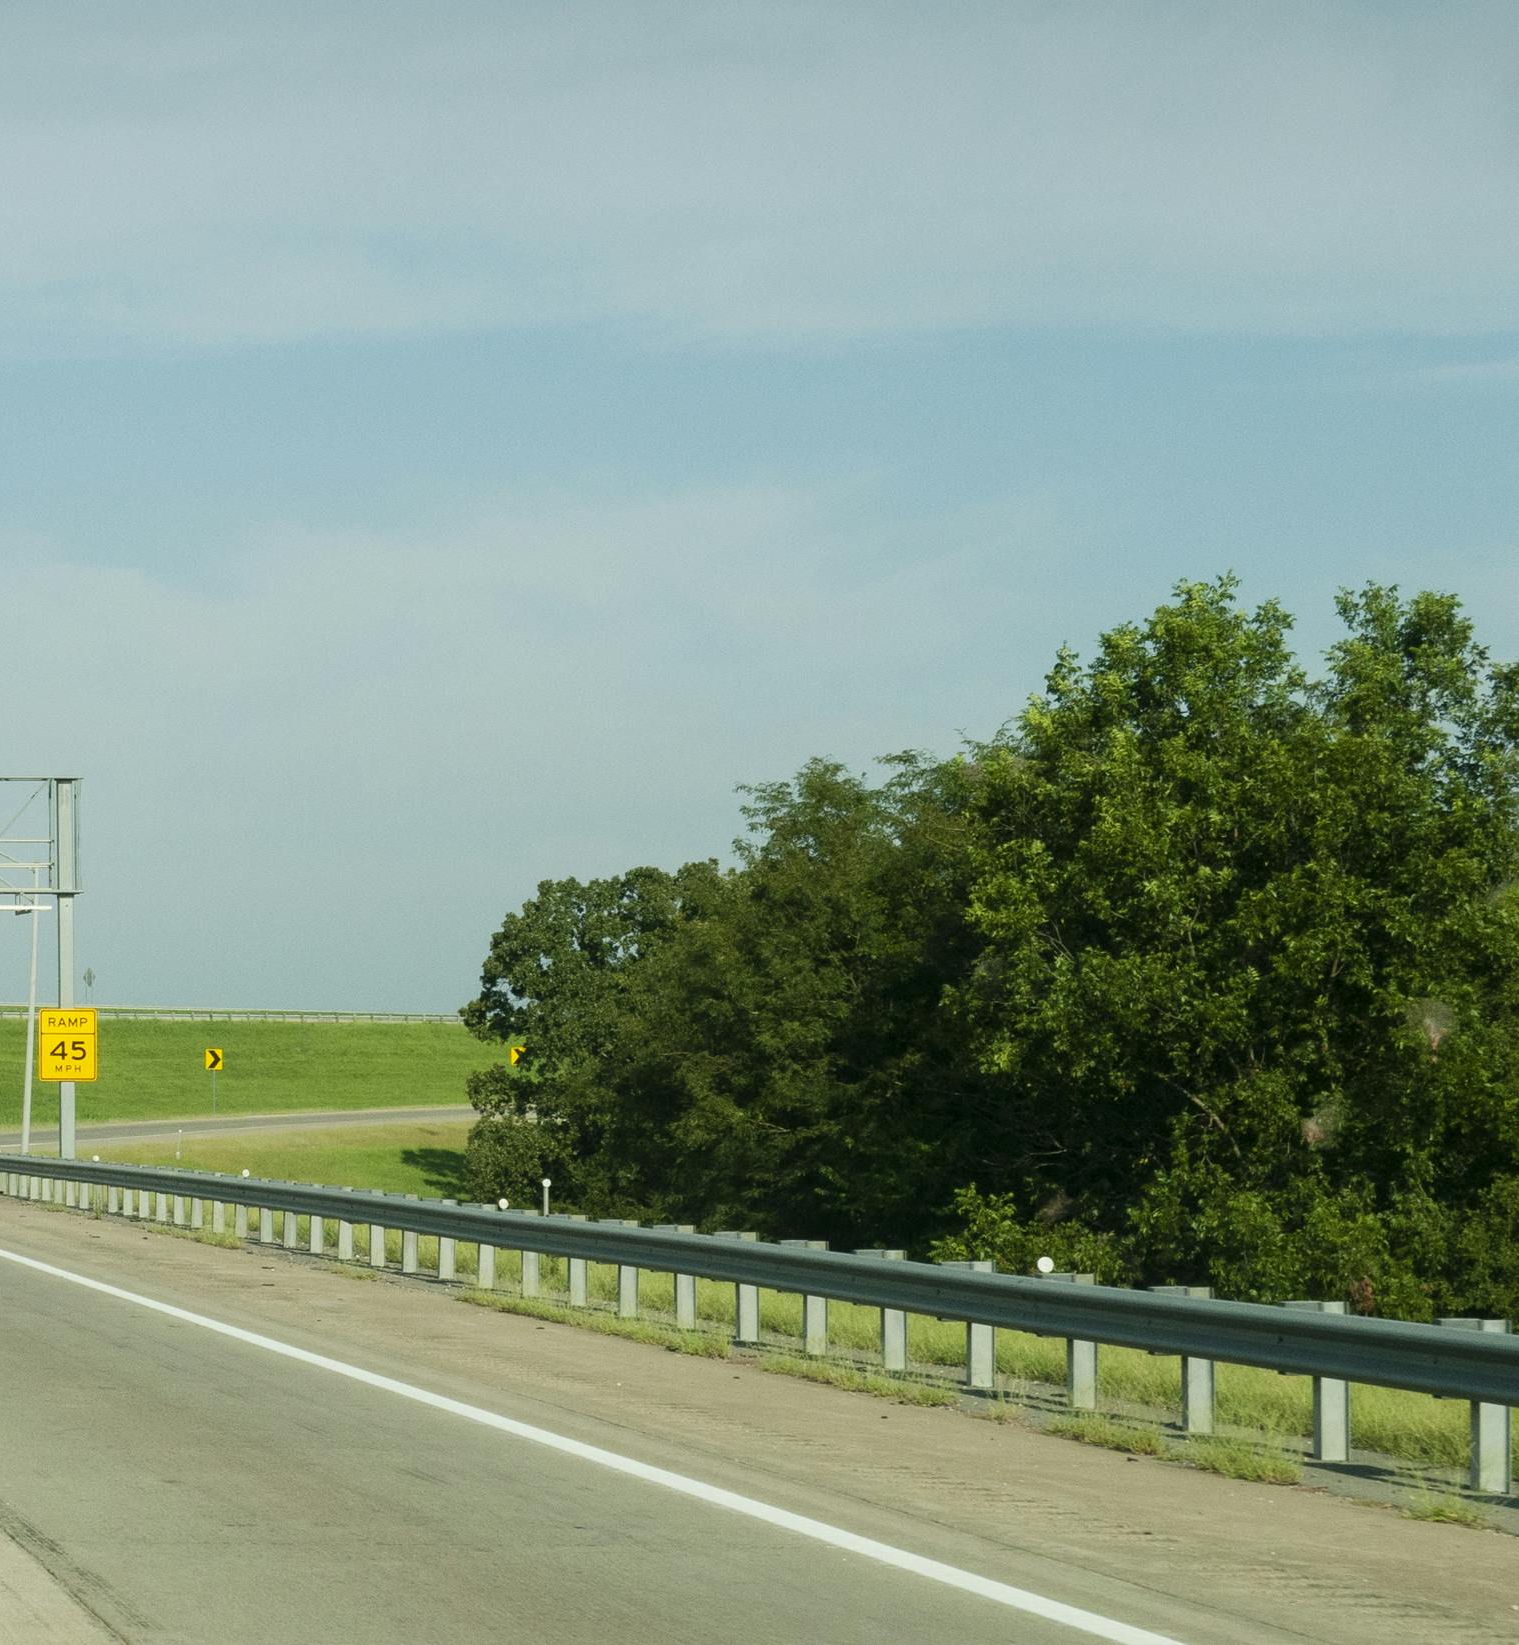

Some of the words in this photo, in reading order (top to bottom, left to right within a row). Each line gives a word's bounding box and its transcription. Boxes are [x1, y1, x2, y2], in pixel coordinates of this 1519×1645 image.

[48, 1017, 88, 1028] RAMP
[50, 1040, 86, 1061] 45
[55, 1064, 82, 1073] MPH
